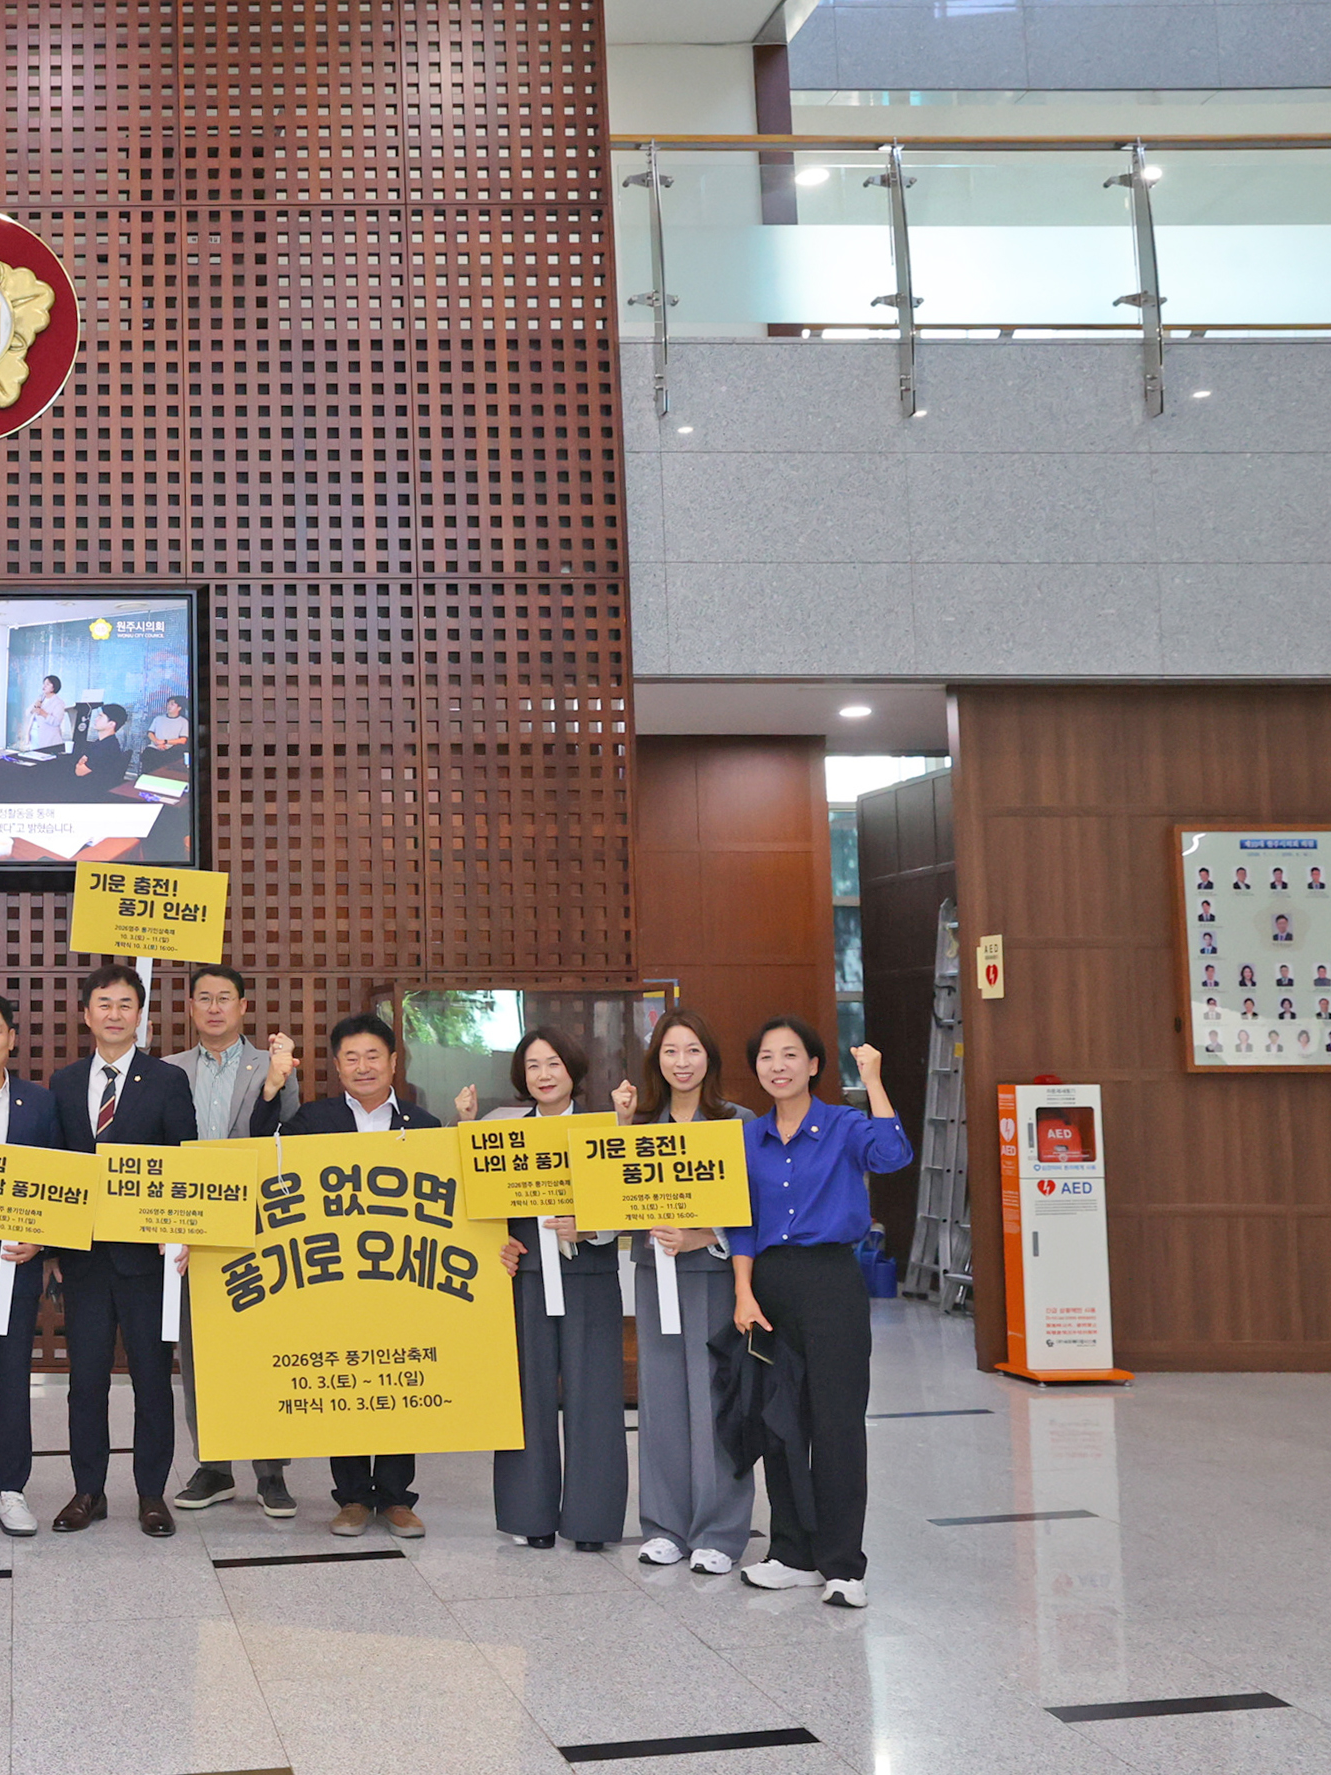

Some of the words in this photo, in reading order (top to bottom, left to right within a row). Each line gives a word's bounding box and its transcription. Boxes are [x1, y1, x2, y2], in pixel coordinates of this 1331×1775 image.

[117, 621, 165, 632] 원주시의회
[37, 809, 55, 819] 통해
[90, 873, 125, 893] 기운
[134, 876, 178, 897] 충전!
[119, 898, 154, 918] 풍기
[163, 902, 207, 922] 인삼!
[141, 927, 175, 935] 풍기인삼축제
[985, 944, 998, 953] AED
[471, 1132, 504, 1150] 나의
[508, 1131, 525, 1148] 힘
[1048, 1129, 1072, 1138] AED
[586, 1138, 626, 1159] 기운
[635, 1135, 686, 1158] 충전!
[1001, 1145, 1016, 1156] AED
[108, 1158, 141, 1174] 나의
[147, 1158, 163, 1175] 힘
[474, 1155, 506, 1172] 나의
[512, 1154, 529, 1171] 삶
[622, 1162, 663, 1184] 풍기
[673, 1160, 725, 1182] 인삼!
[12, 1180, 89, 1205] 풍기인삼!
[107, 1180, 140, 1197] 나의
[147, 1181, 164, 1198] 삶
[171, 1182, 247, 1201] 풍기인삼!
[653, 1192, 692, 1200] 풍기인삼축제
[1061, 1182, 1092, 1194] AED
[257, 1172, 306, 1234] 운
[319, 1164, 457, 1229] 없으면
[7, 1207, 43, 1217] 풍기인삼축제
[167, 1209, 203, 1217] 풍기인삼축제
[625, 1213, 644, 1221] 개막식
[8, 1224, 23, 1232] 3.(토)
[18, 1217, 36, 1225] 11.(일)
[221, 1232, 344, 1312] 풍기로
[357, 1230, 479, 1303] 오세요
[272, 1351, 339, 1369] 2026영주
[345, 1347, 438, 1365] 풍기인삼축제
[291, 1375, 312, 1390] 10.
[317, 1372, 357, 1390] 3.(토)
[378, 1370, 424, 1388] 11.(일)
[278, 1397, 324, 1415] 개막식
[330, 1396, 351, 1412] 10.
[357, 1394, 396, 1412] 3.(토)
[402, 1393, 453, 1409] 16:00~
